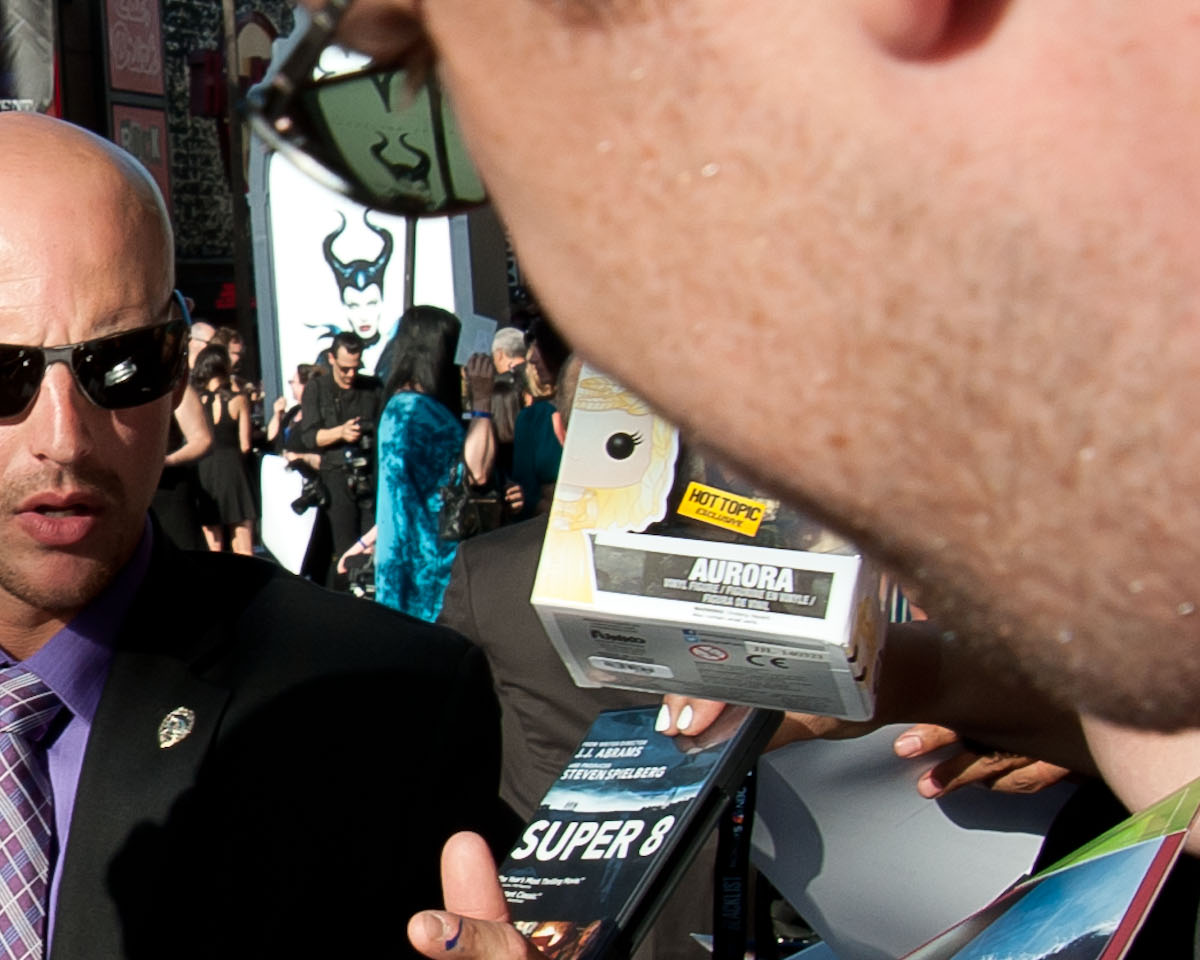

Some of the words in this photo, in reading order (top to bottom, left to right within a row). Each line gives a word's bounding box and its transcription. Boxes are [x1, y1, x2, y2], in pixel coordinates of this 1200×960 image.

[688, 488, 720, 508] HOT
[720, 497, 761, 522] TOPIC
[695, 508, 745, 527] EXCLUSIVE
[688, 558, 794, 593] AURORA
[594, 746, 644, 759] ABRAMS
[560, 769, 606, 780] STEVEN
[604, 766, 667, 780] SPIELBERG
[510, 819, 645, 861] SUPER
[638, 814, 676, 857] 8
